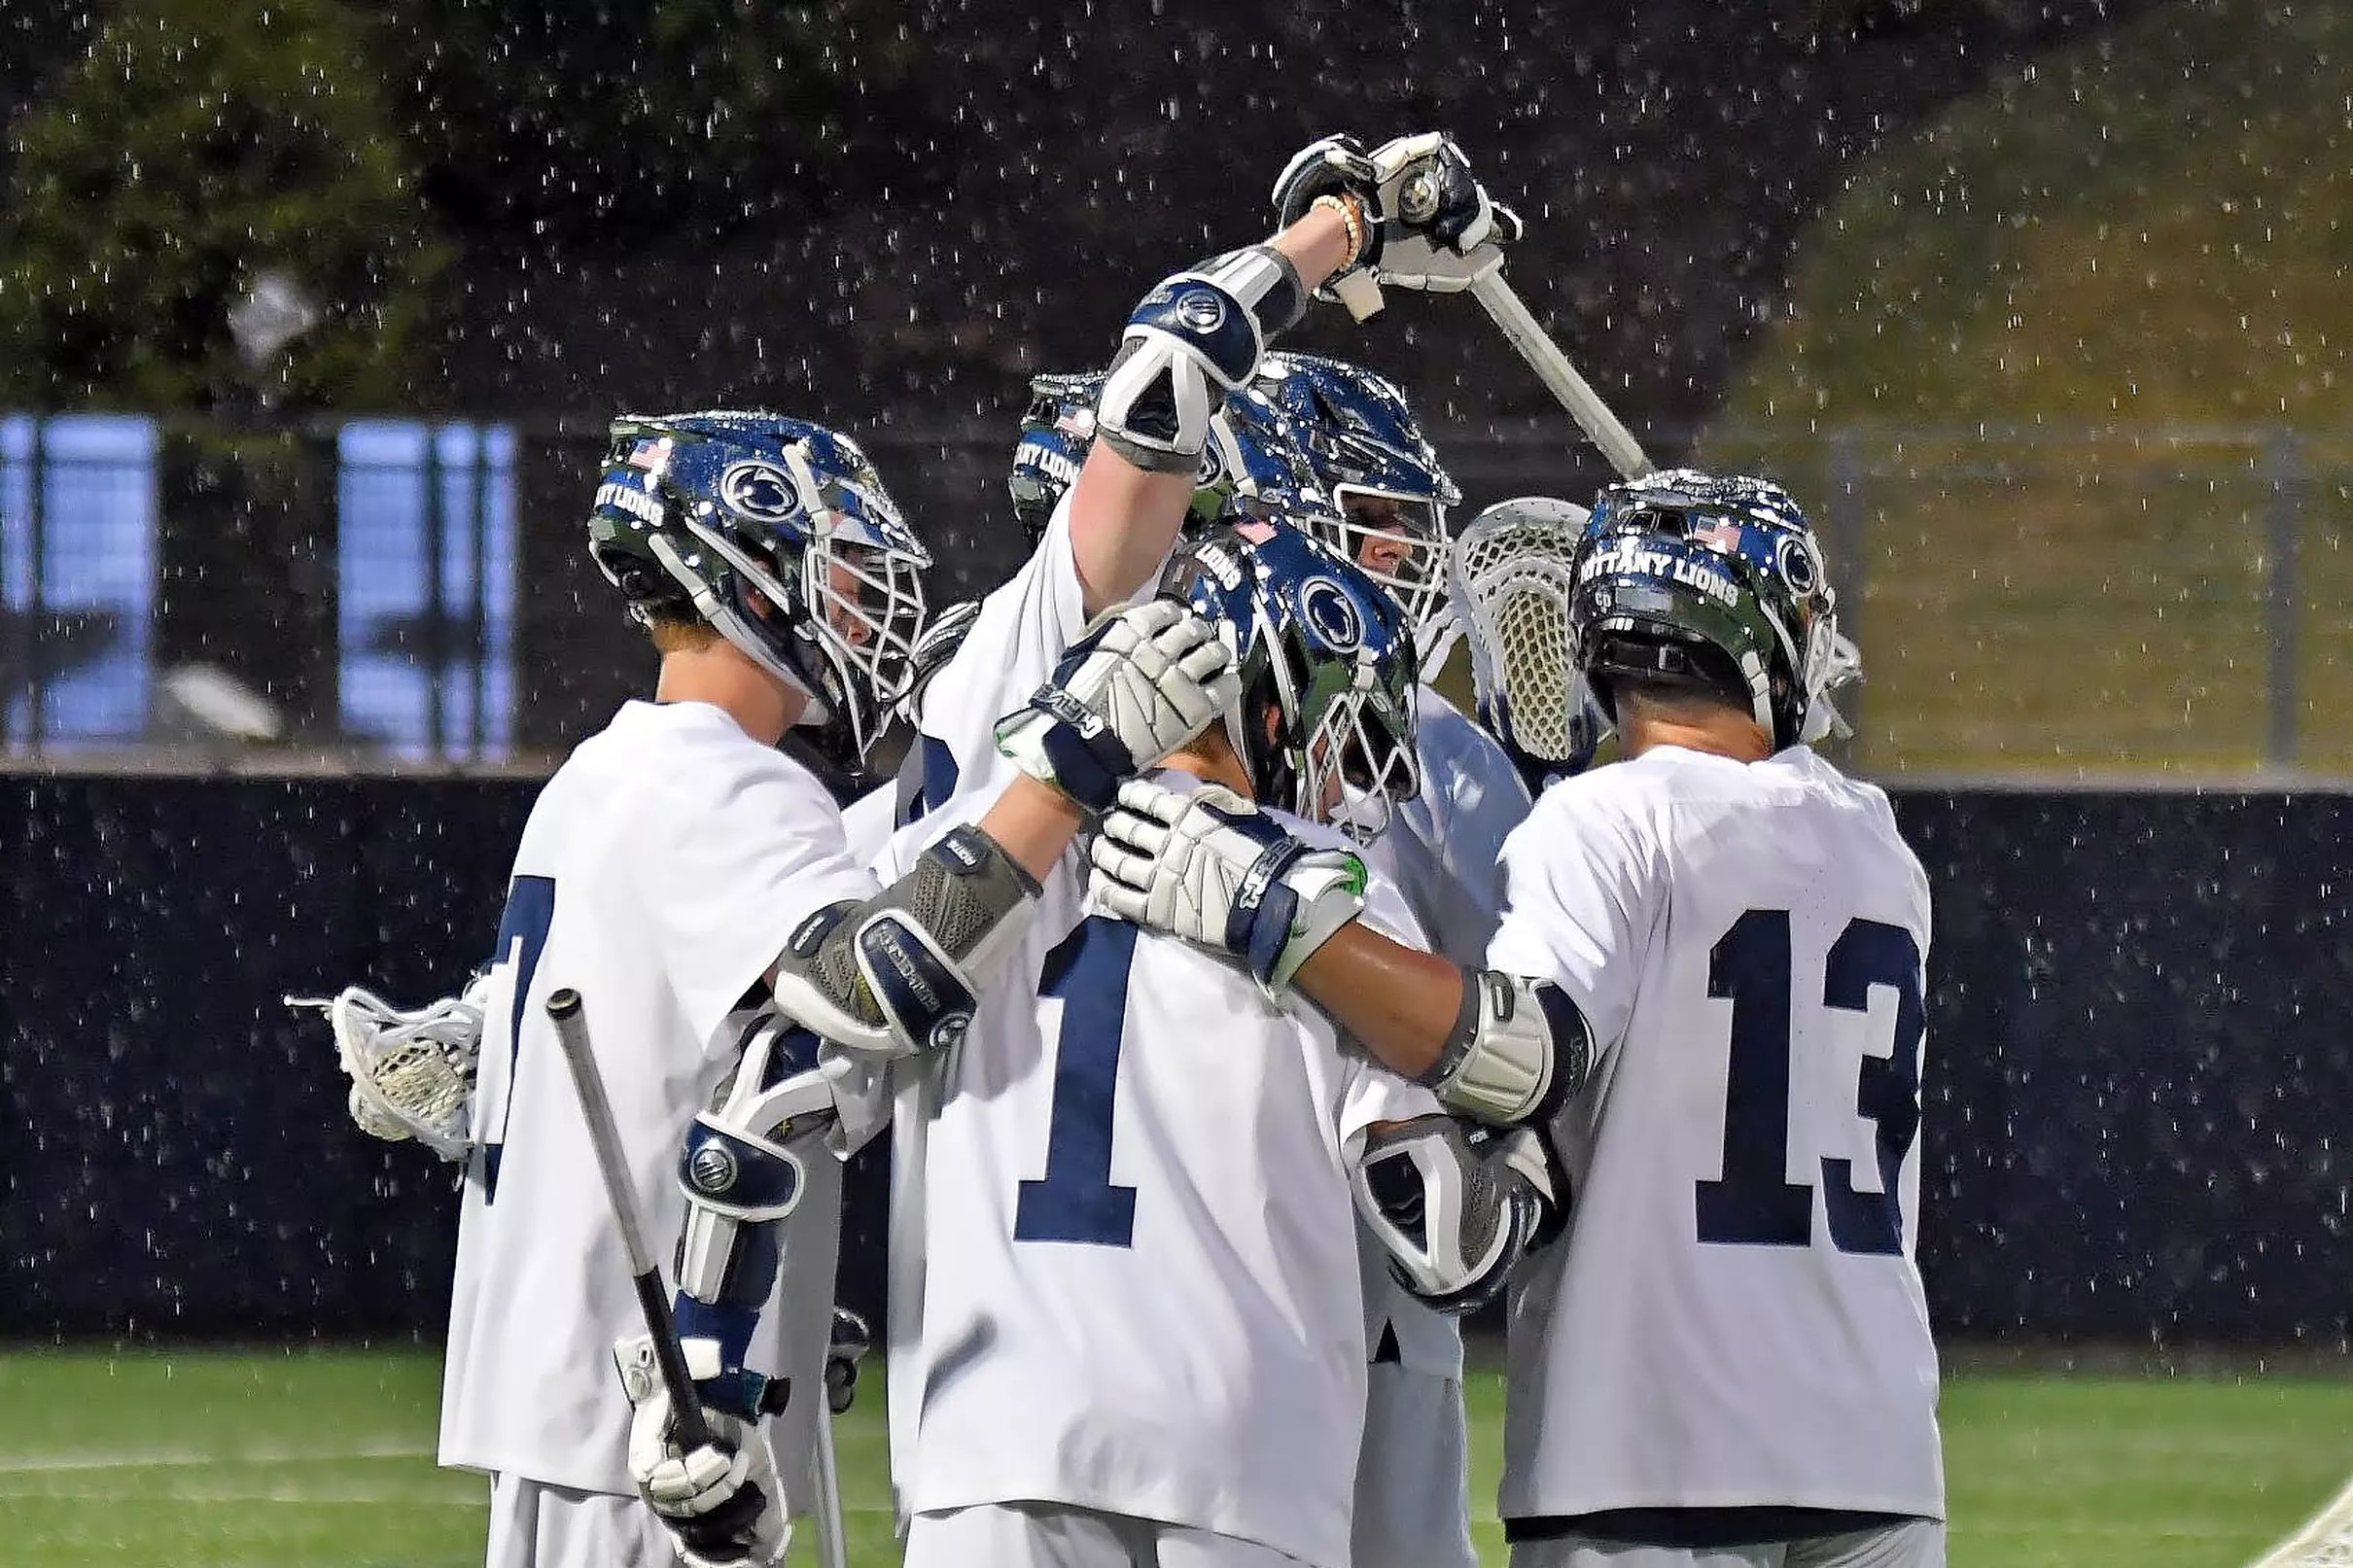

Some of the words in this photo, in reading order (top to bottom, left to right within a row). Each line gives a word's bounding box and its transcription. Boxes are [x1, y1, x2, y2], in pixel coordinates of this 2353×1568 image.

[1038, 447, 1077, 484] LION
[614, 485, 664, 527] LIONS
[1194, 541, 1242, 591] LIONS
[1672, 557, 1738, 609] LIONS
[1013, 914, 1139, 1248] 1
[1695, 908, 1927, 1257] 13
